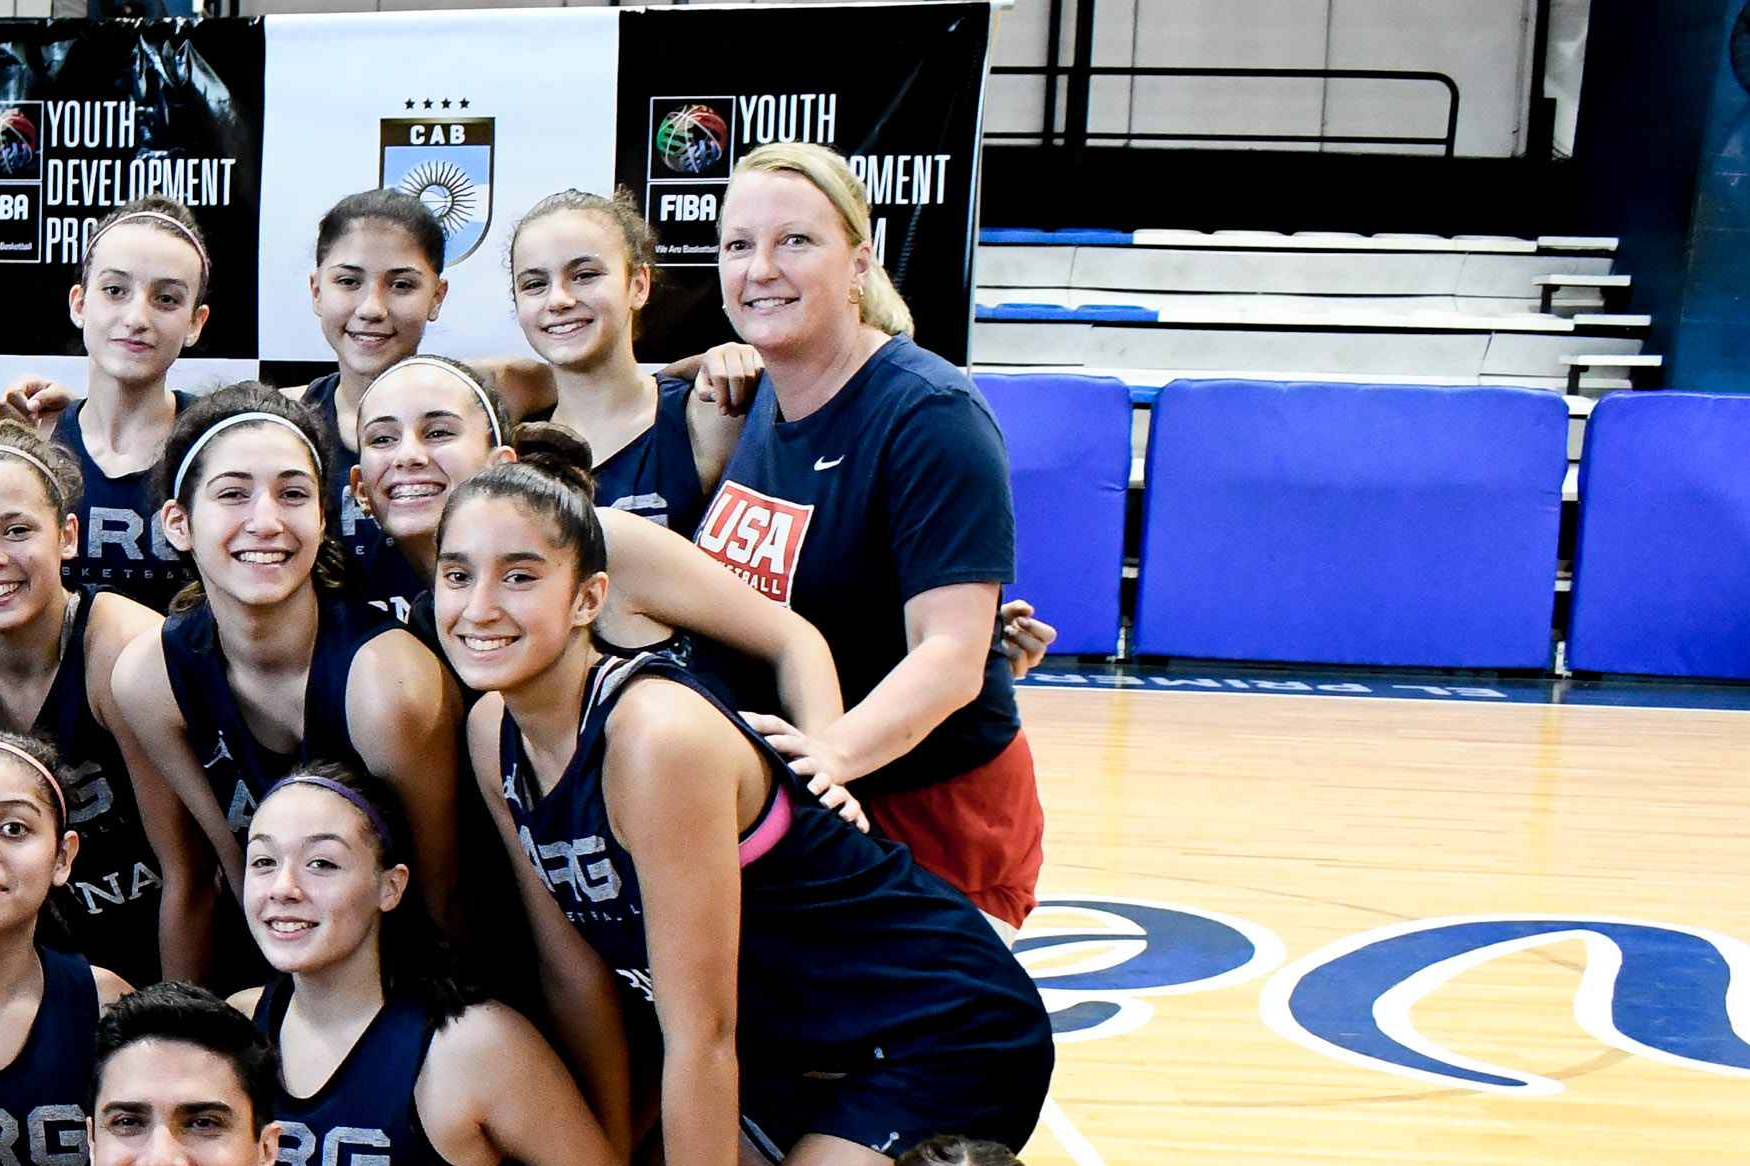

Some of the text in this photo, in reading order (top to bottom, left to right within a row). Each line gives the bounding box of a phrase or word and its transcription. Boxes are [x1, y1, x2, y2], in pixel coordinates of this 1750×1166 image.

[47, 100, 136, 148] YOUTH
[410, 125, 465, 145] CAB
[739, 93, 837, 144] YOUTH
[47, 158, 236, 206] DEVELOPMENT
[660, 194, 717, 222] FIBA
[700, 493, 794, 574] USA
[66, 861, 162, 915] NA
